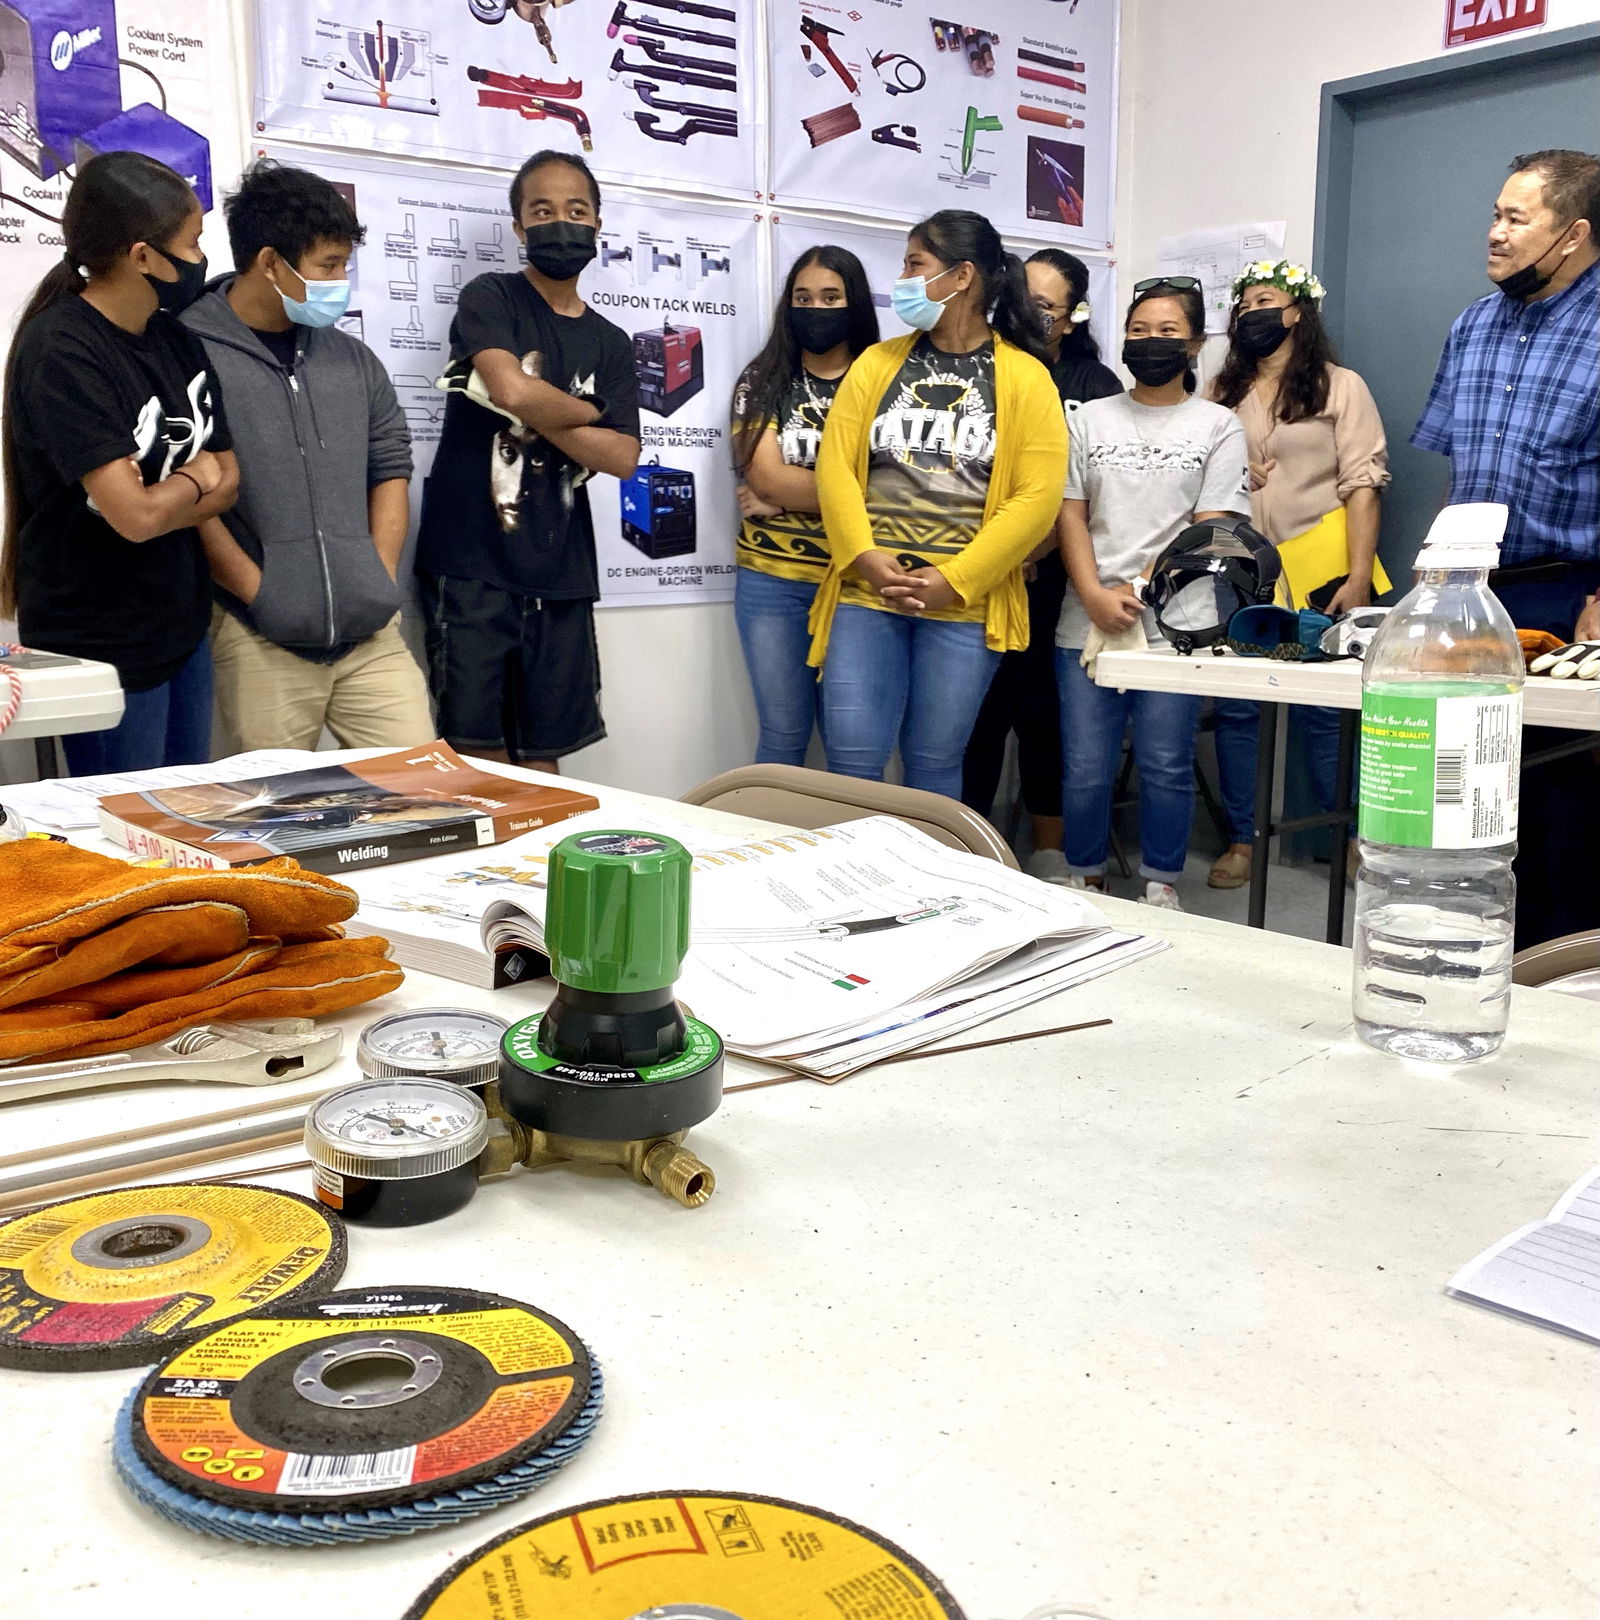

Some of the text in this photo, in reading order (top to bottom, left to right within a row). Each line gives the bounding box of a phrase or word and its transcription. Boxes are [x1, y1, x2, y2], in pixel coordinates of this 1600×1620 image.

[1453, 0, 1536, 30] EX
[127, 26, 203, 48] Coolant System
[1023, 36, 1077, 55] Standard Welding Cable
[128, 43, 186, 62] Power Cord
[23, 186, 63, 200] Coolant
[592, 292, 736, 316] COUPON TACK WELDS
[643, 426, 722, 438] ENGINE-DRIVEN
[668, 437, 714, 448] MACHINE
[607, 568, 622, 578] DC
[625, 566, 702, 577] ENGINE-DRIVEN
[658, 576, 703, 586] MACHINE
[1403, 717, 1429, 727] Health
[1398, 731, 1431, 740] QUALITY
[509, 818, 544, 831] Trainee Guide
[430, 834, 459, 844] Fifth Edition
[337, 845, 389, 864] Welding
[365, 1294, 403, 1302] 71986
[276, 1321, 319, 1329] 4-1/2"
[336, 1320, 367, 1328] 7/8"
[370, 1318, 422, 1328] (115mm
[441, 1313, 484, 1322] 22mm)
[174, 1380, 219, 1388] ZA 60
